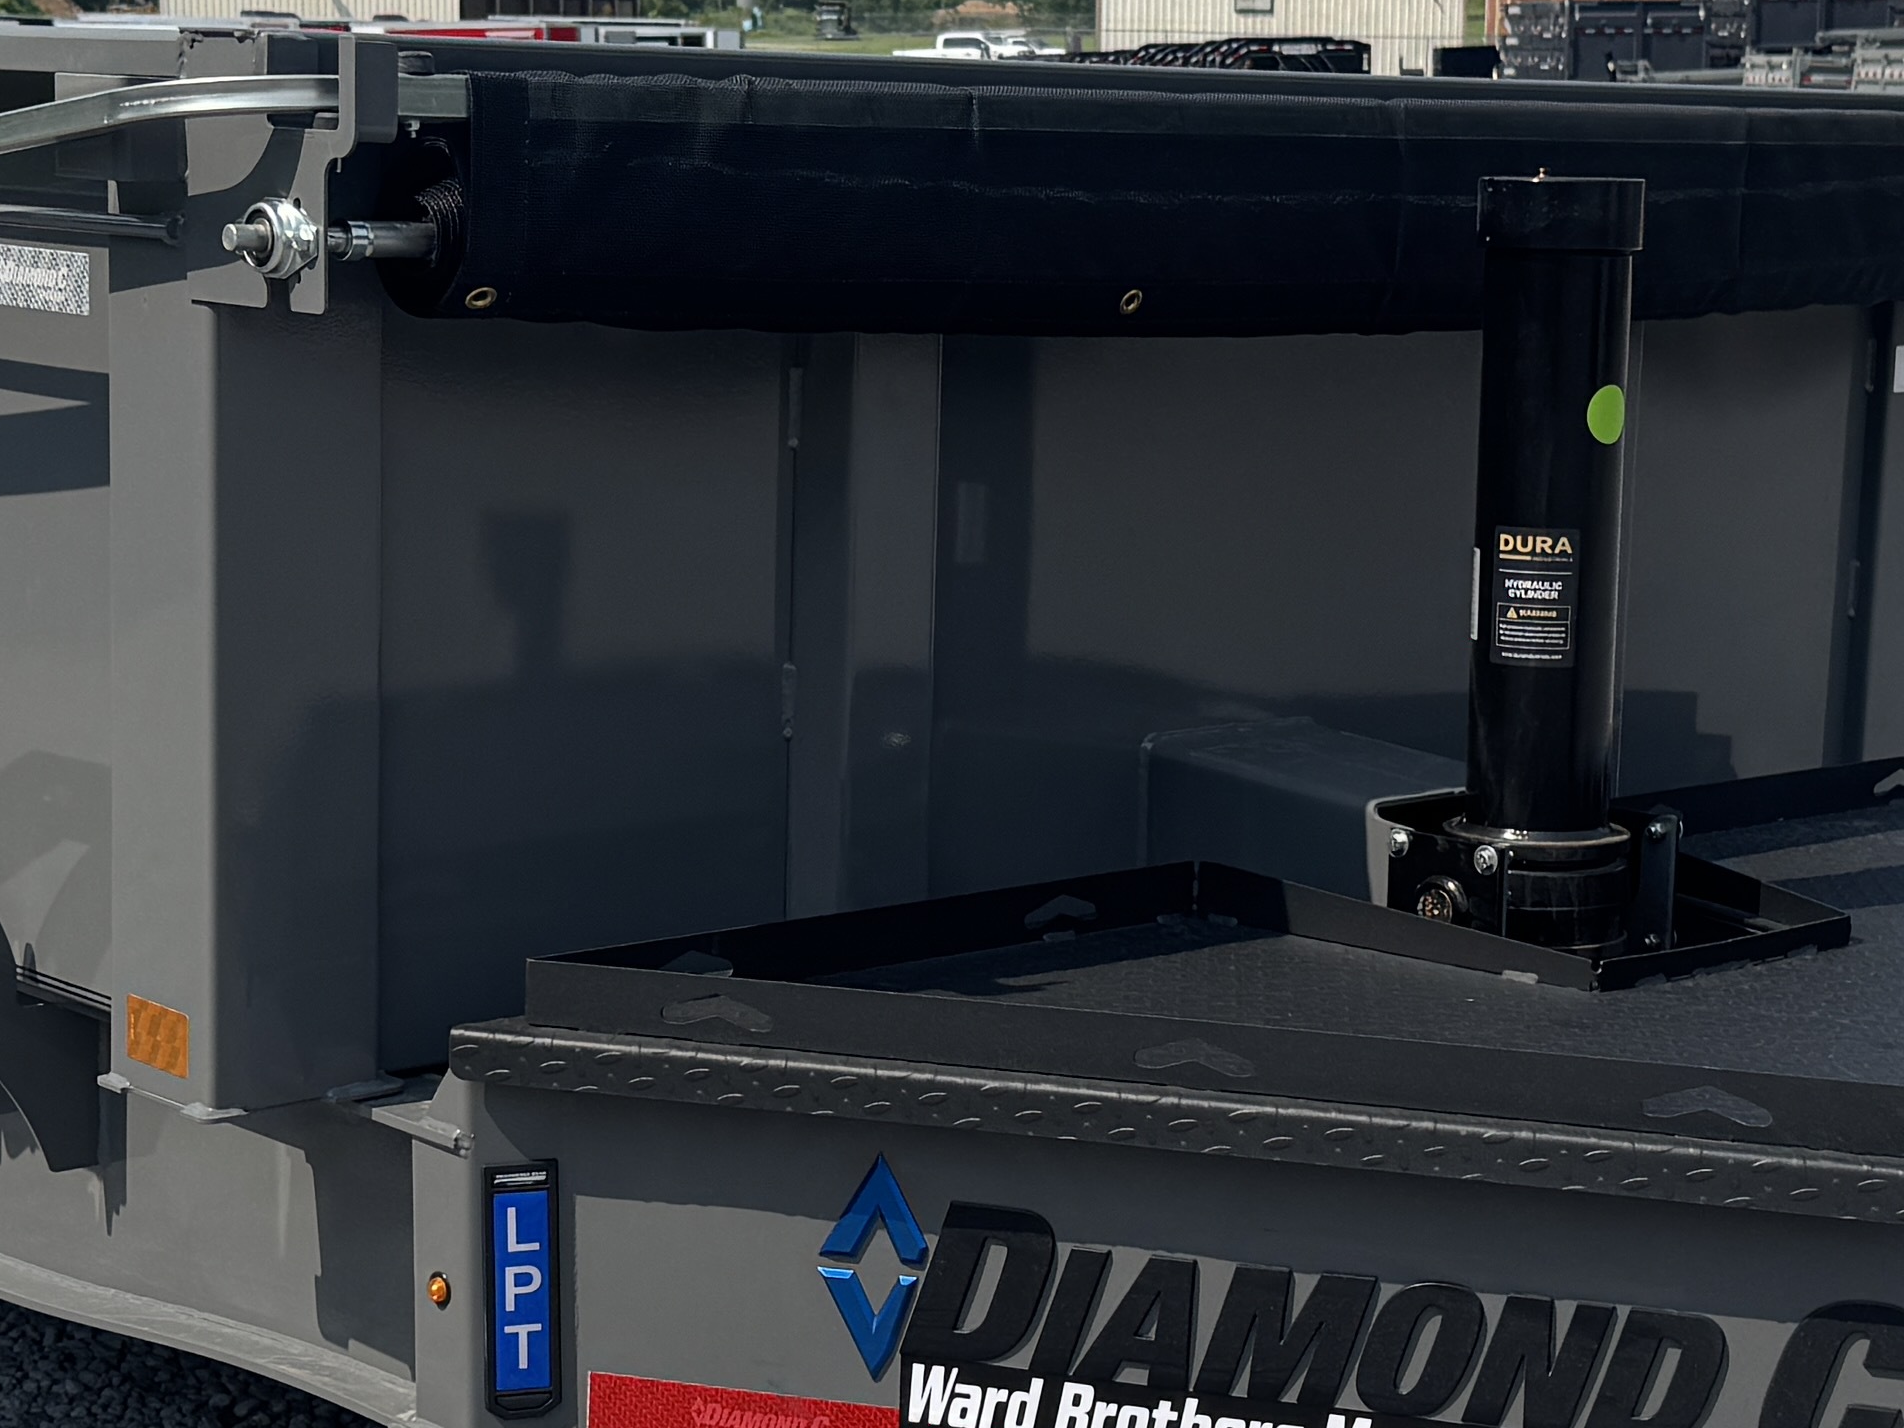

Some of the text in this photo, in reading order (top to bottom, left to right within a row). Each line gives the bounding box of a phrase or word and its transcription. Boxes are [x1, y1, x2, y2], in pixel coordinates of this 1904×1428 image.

[1499, 533, 1573, 554] DURA
[1504, 578, 1563, 591] HYDRAULIC
[1508, 588, 1559, 600] CYLINDER
[504, 1207, 542, 1369] LPT
